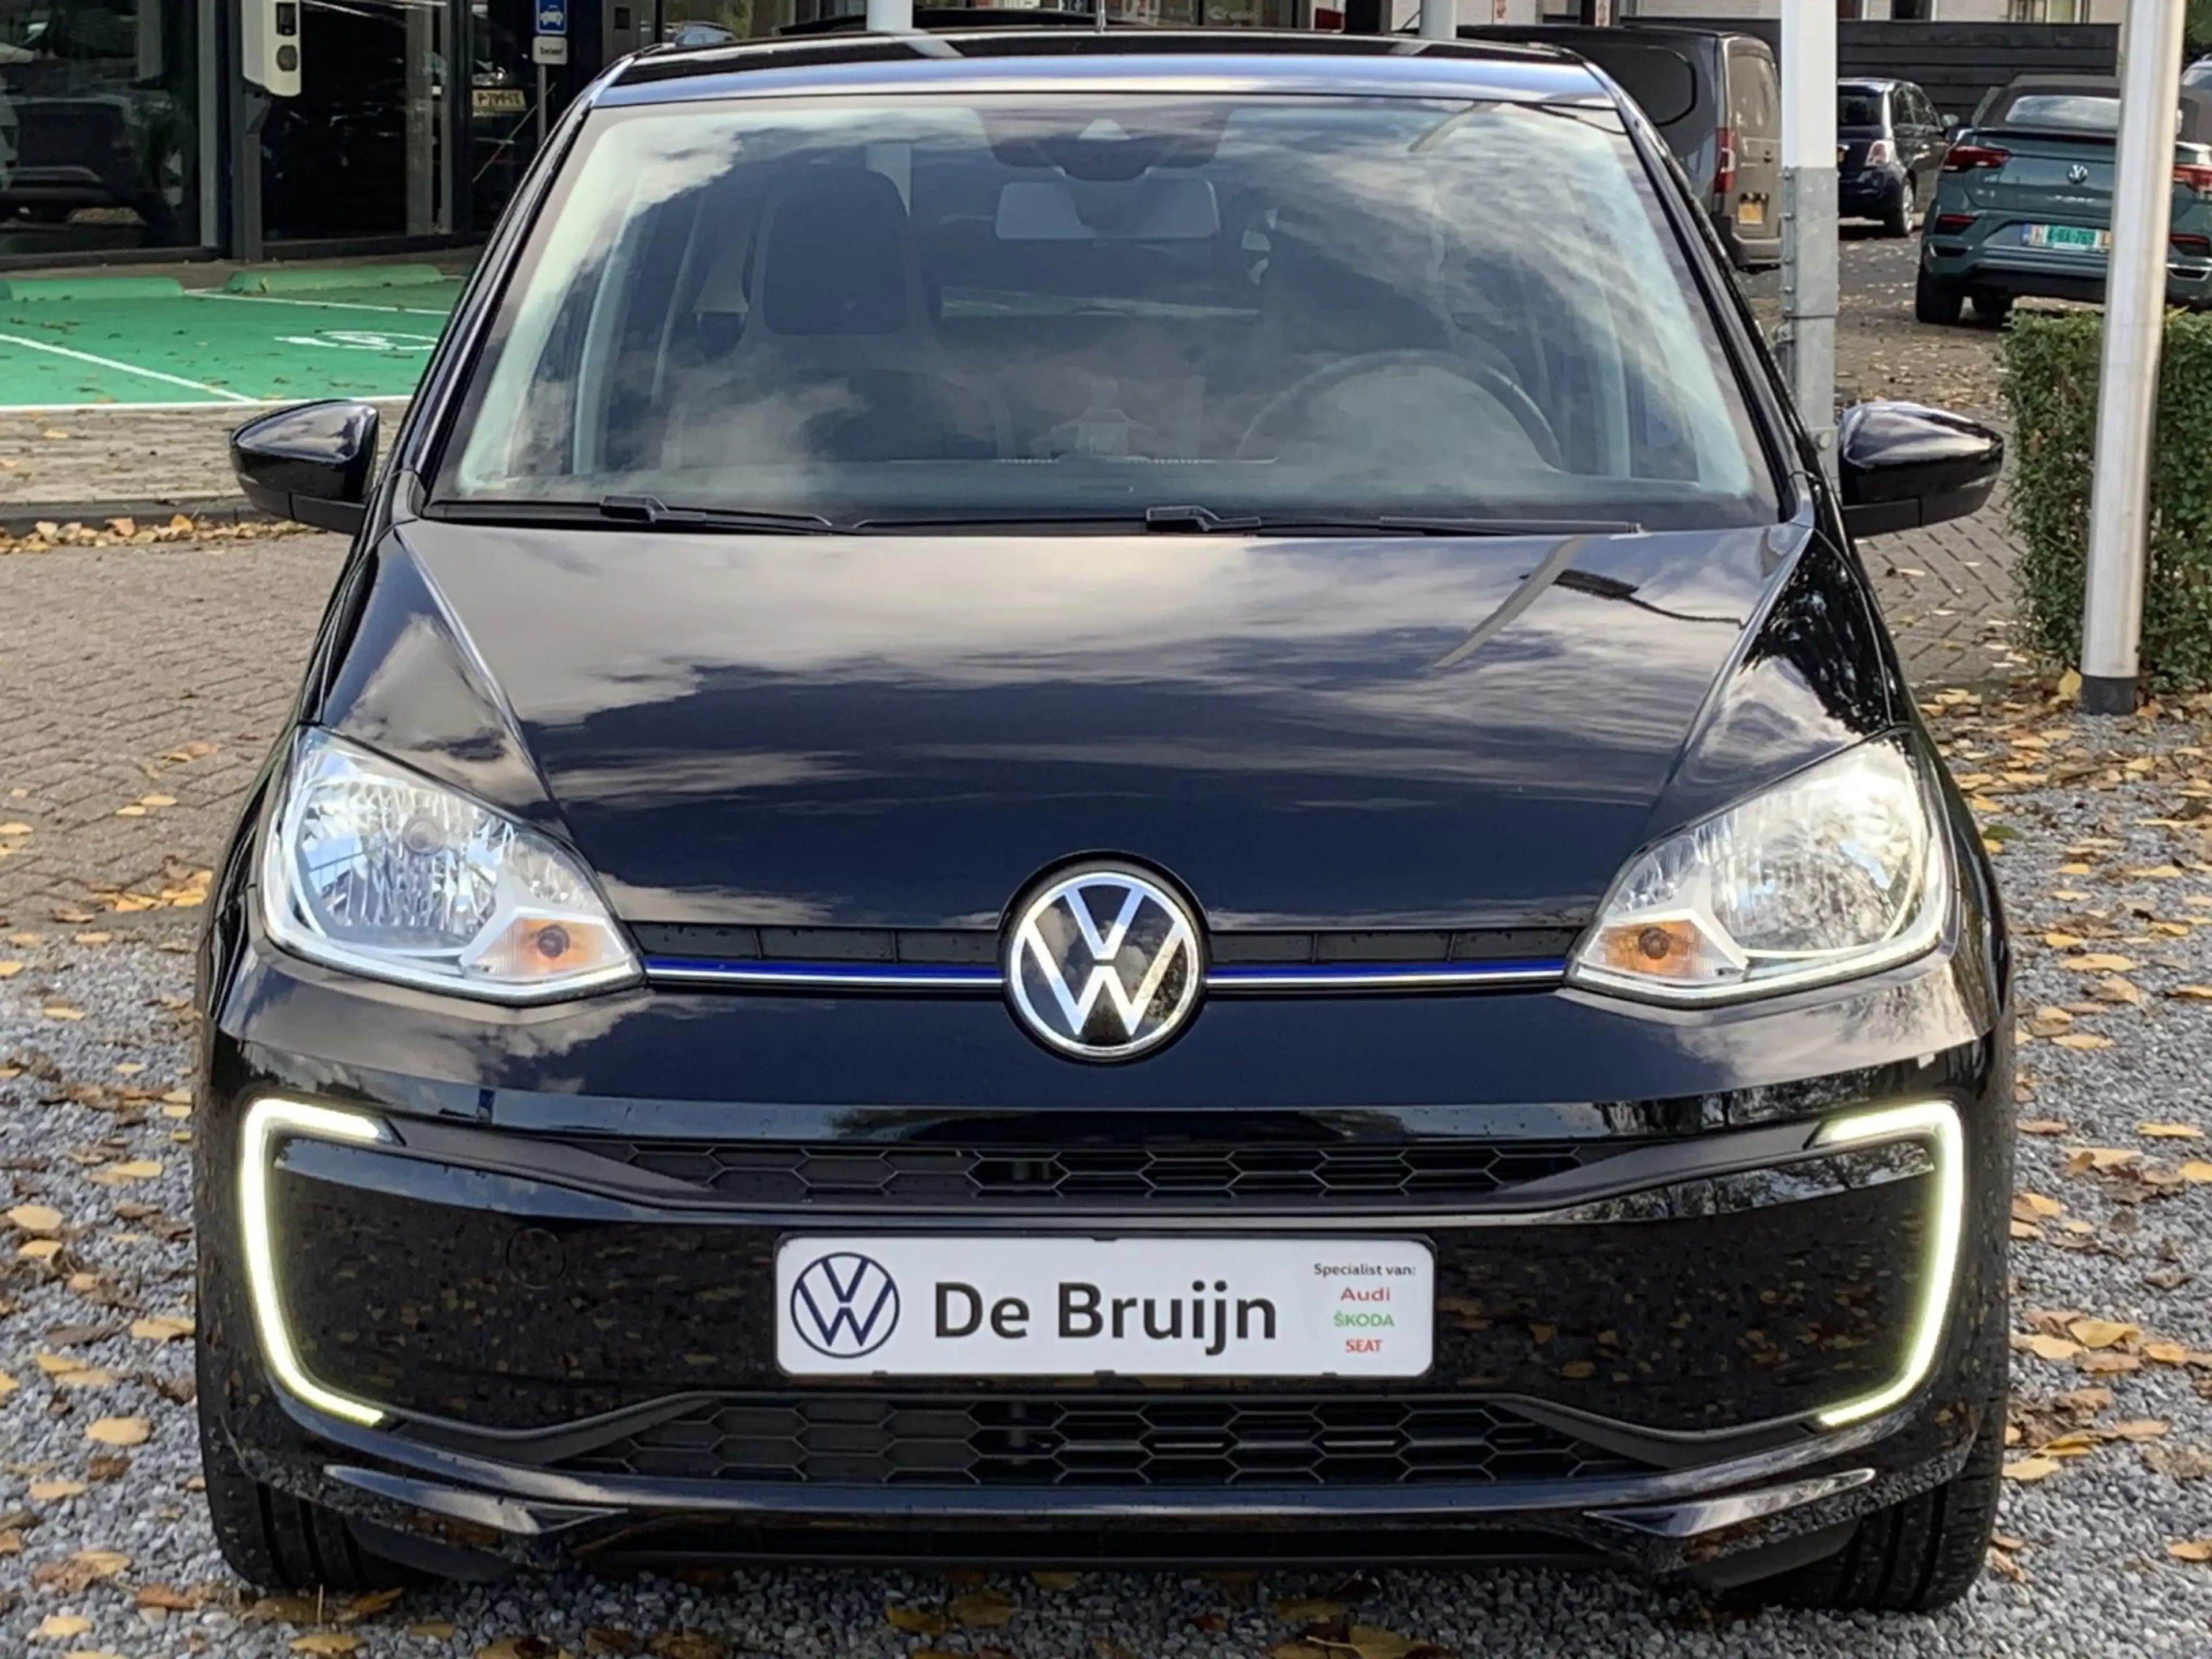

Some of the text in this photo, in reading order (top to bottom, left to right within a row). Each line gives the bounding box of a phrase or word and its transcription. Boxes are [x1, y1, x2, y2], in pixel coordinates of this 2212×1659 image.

[1021, 881, 1188, 1038] VW
[1314, 1263, 1383, 1278] Specialist
[797, 1256, 895, 1348] VW
[1340, 1287, 1391, 1302] Audi
[935, 1280, 1276, 1356] De Bruijn
[1334, 1310, 1395, 1327] ŠKODA
[1345, 1339, 1383, 1353] SEAT
